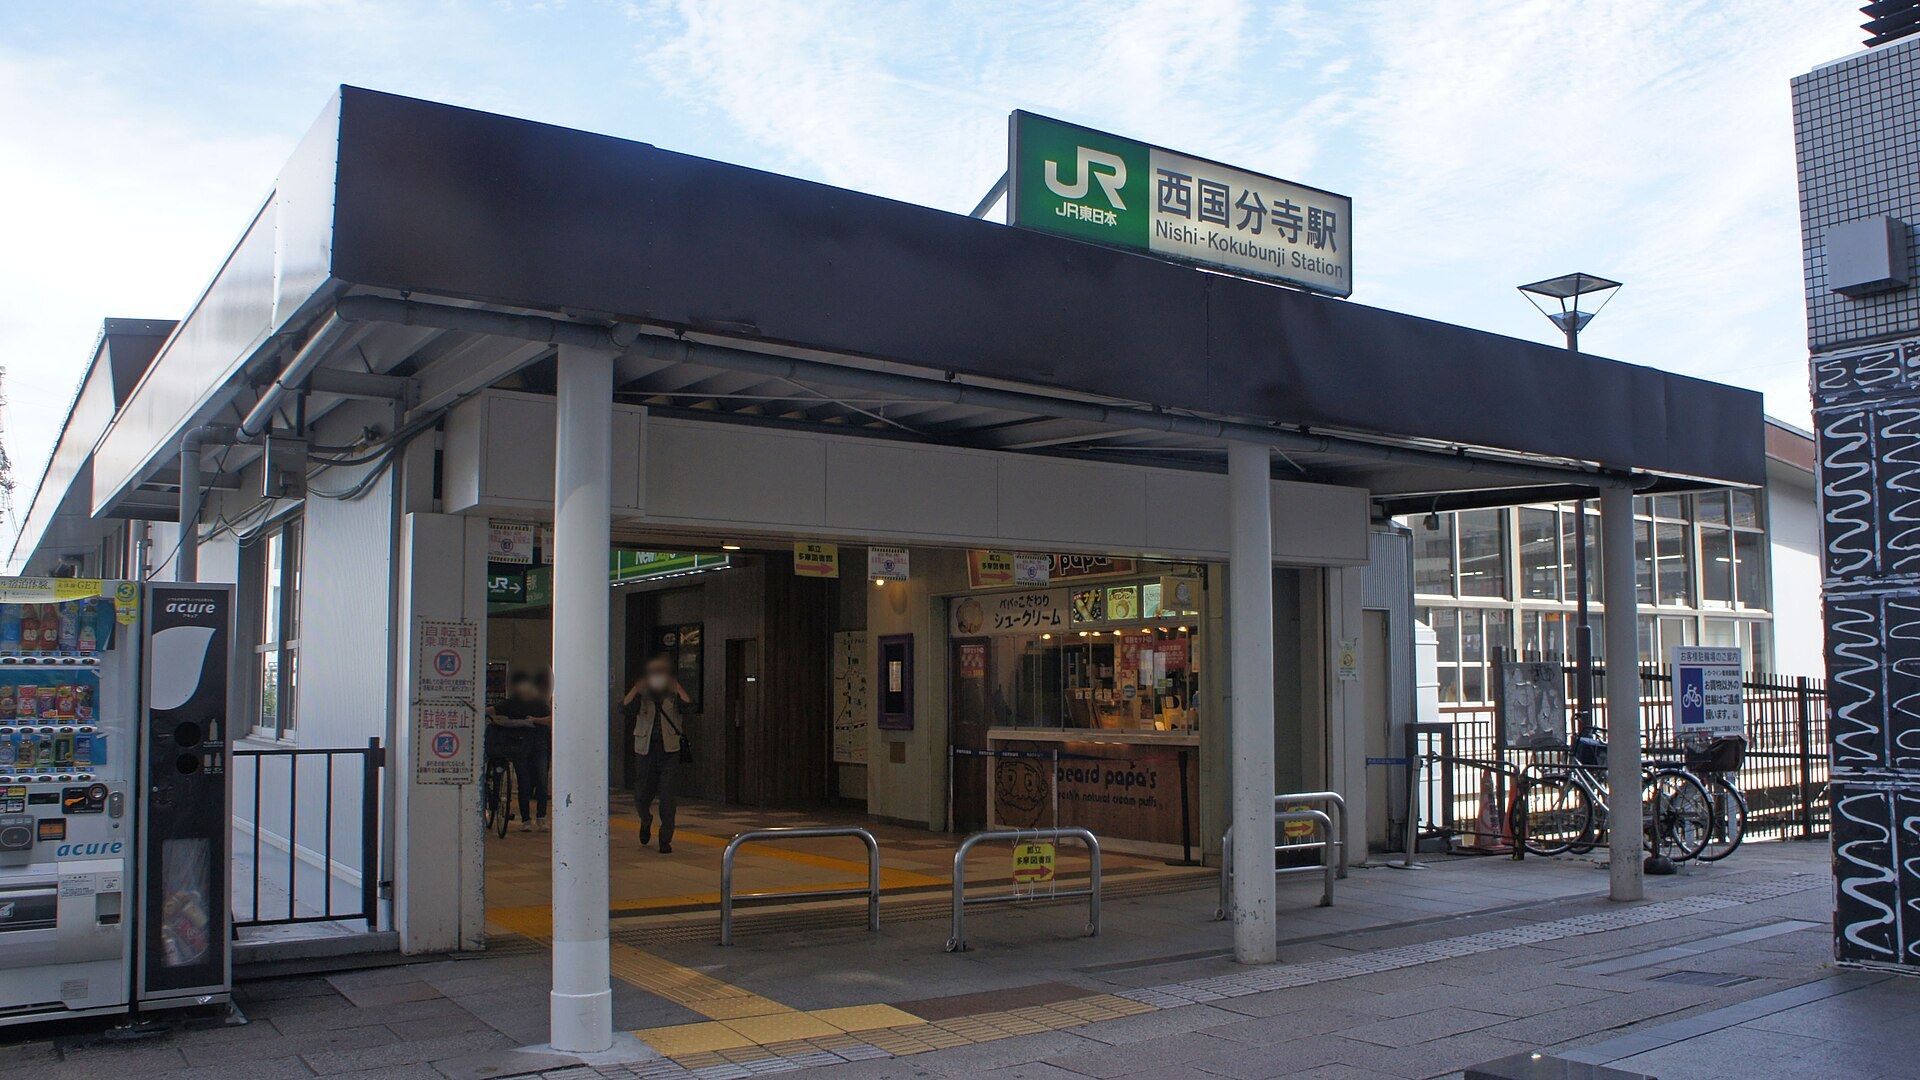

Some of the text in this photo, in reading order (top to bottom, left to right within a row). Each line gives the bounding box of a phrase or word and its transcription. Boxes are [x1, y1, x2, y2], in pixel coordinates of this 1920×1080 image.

[1044, 145, 1127, 211] JR
[1055, 201, 1118, 227] JR東日本
[1156, 168, 1338, 253] 西国分寺駅
[1156, 219, 1343, 279] Nishi-Kokubunji Station
[166, 602, 216, 613] acure
[995, 608, 1061, 629] シュークリーム
[425, 627, 472, 637] 自転車
[423, 709, 470, 729] 駐輪禁止
[1082, 792, 1110, 804] natural
[1112, 796, 1136, 806] cream
[57, 842, 122, 857] acure
